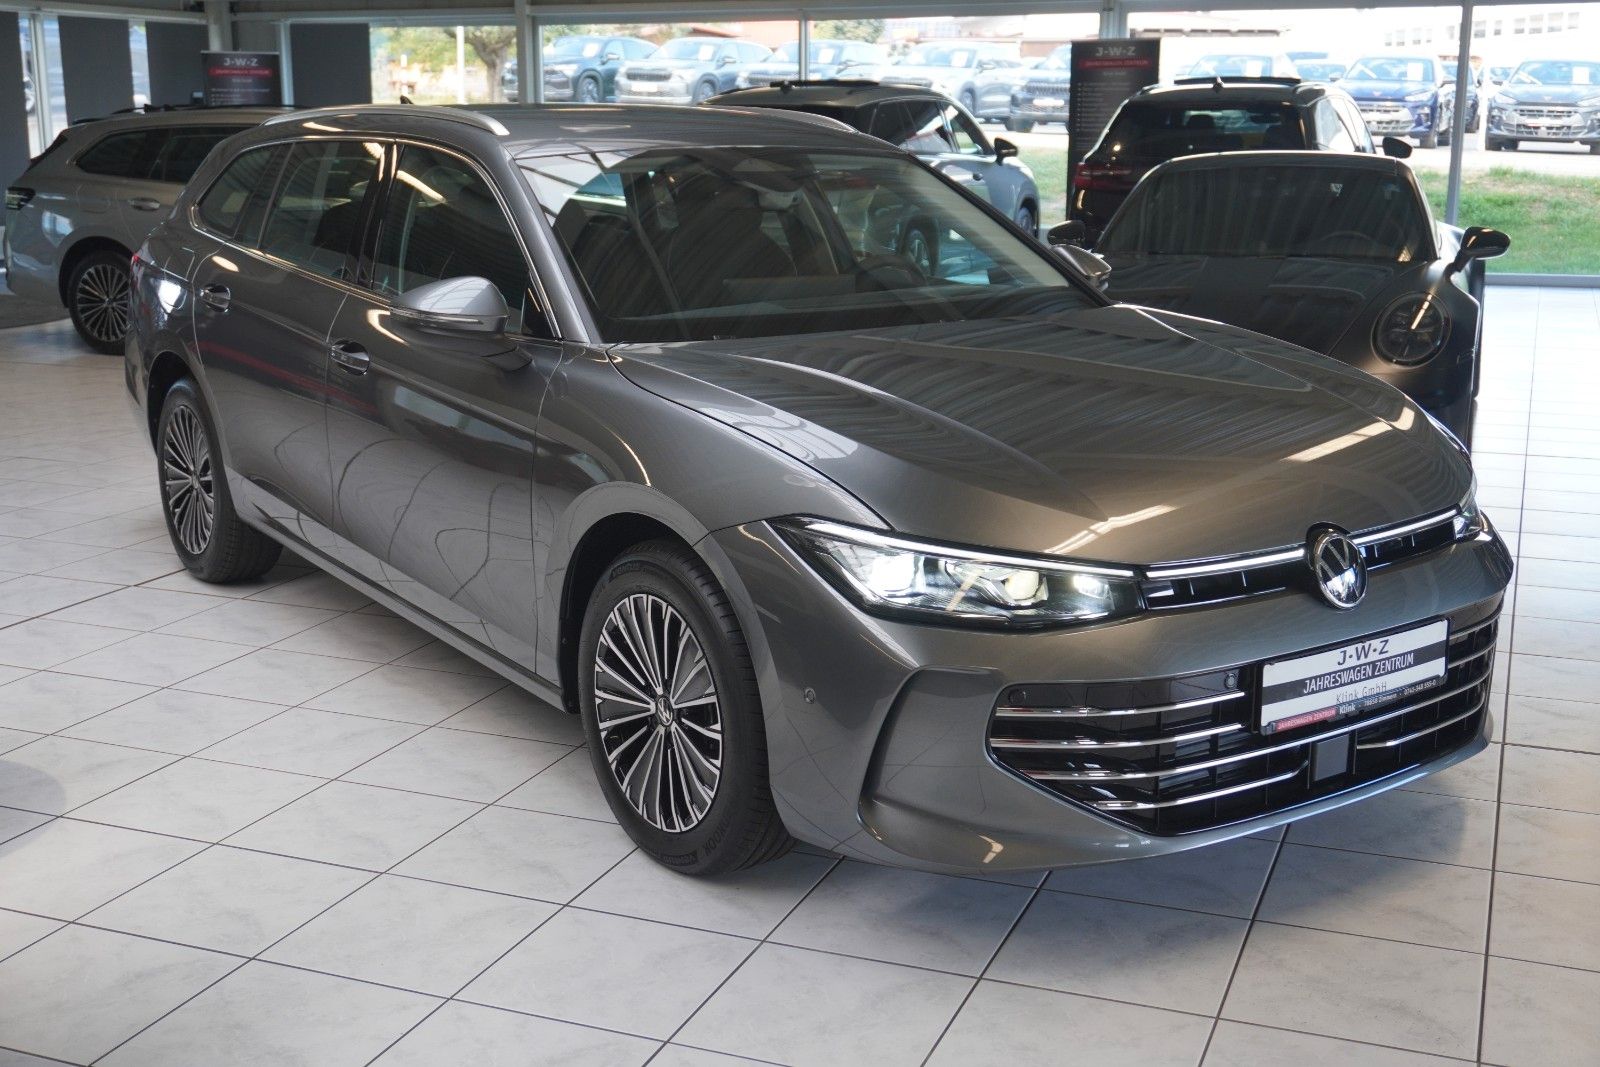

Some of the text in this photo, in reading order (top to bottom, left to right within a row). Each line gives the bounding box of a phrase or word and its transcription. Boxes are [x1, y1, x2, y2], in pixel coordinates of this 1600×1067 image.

[1303, 653, 1414, 694] JAHRESWAGEN ZENTRUM
[1336, 681, 1387, 704] Klink GmbH
[1340, 703, 1356, 714] Klink
